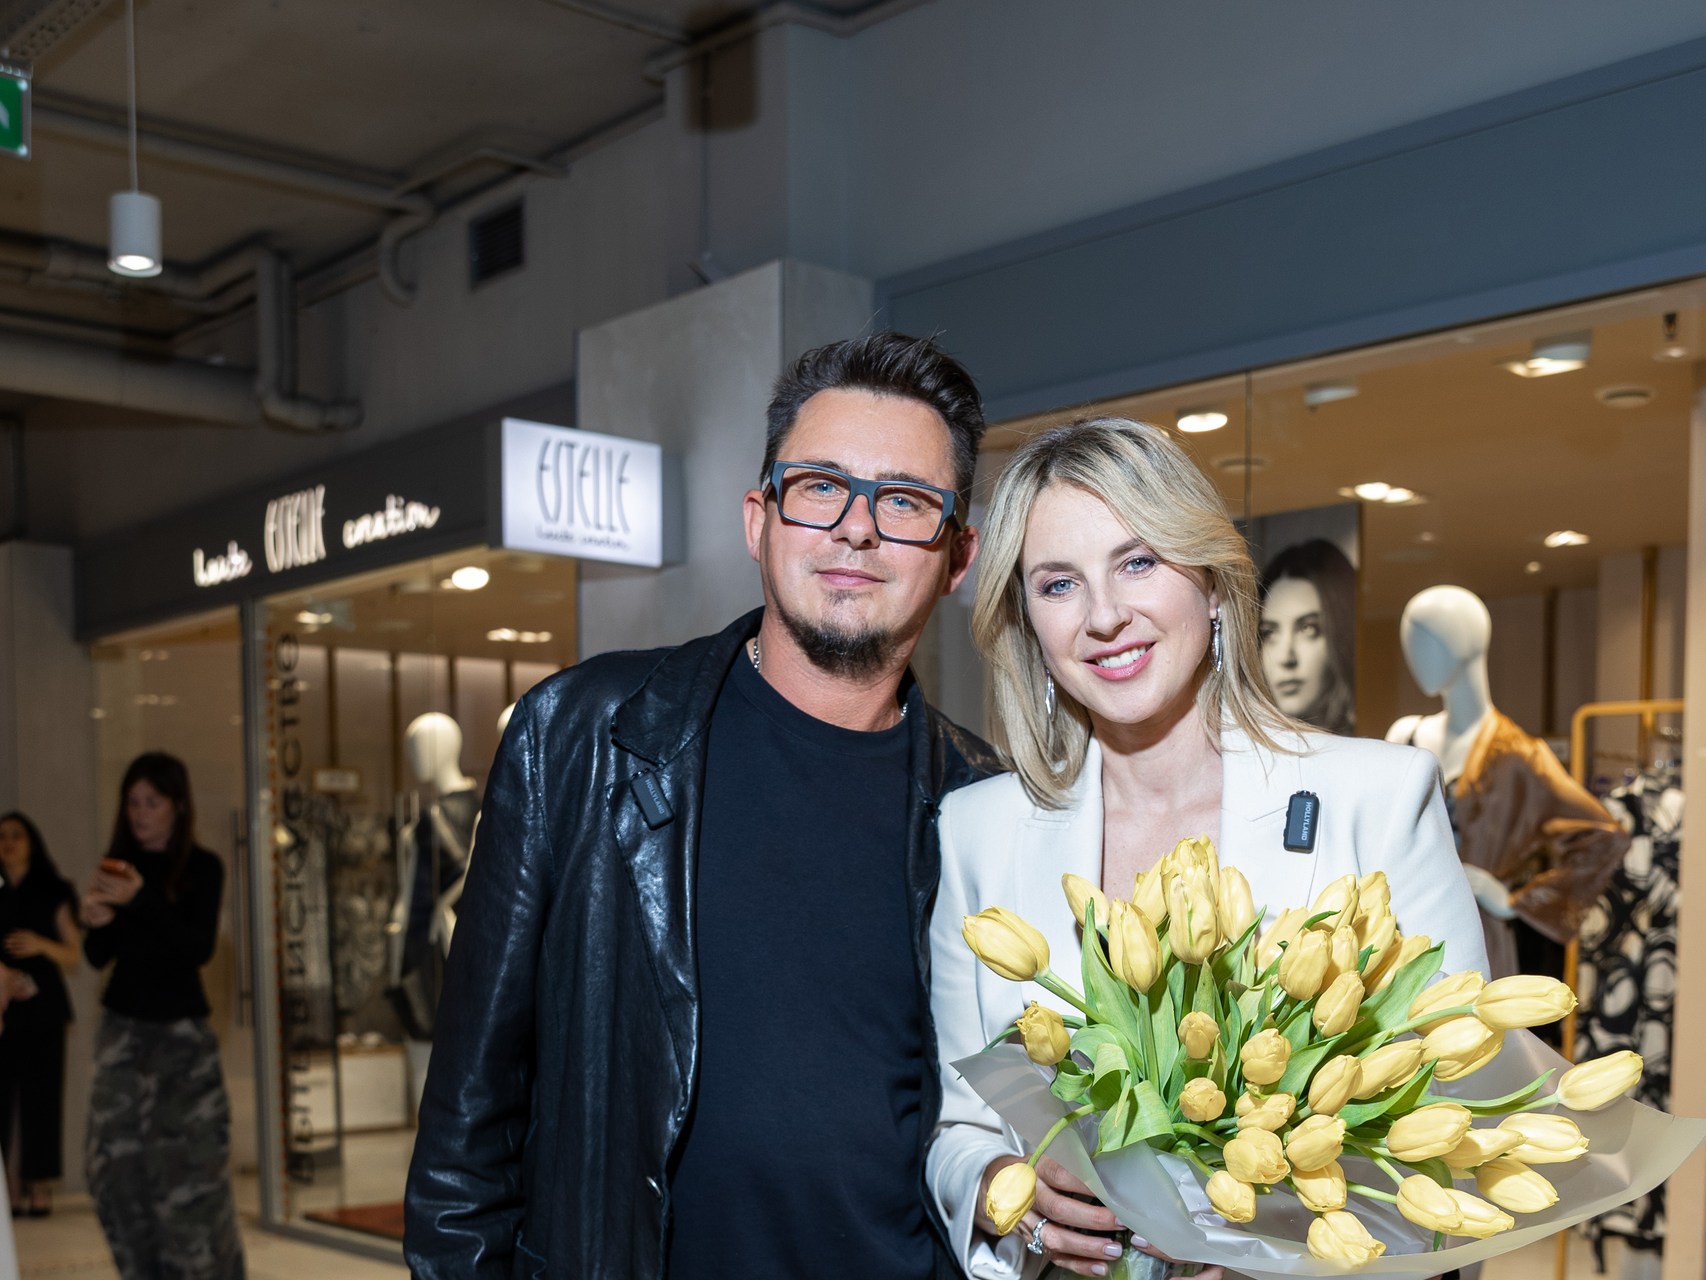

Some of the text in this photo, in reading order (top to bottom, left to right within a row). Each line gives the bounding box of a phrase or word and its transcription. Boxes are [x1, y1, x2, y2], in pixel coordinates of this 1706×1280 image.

[536, 437, 631, 534] ESTELLE
[264, 484, 327, 573] ESTELLE
[644, 779, 665, 815] HOLLYLAND
[1301, 801, 1313, 841] HOLLYLAND
